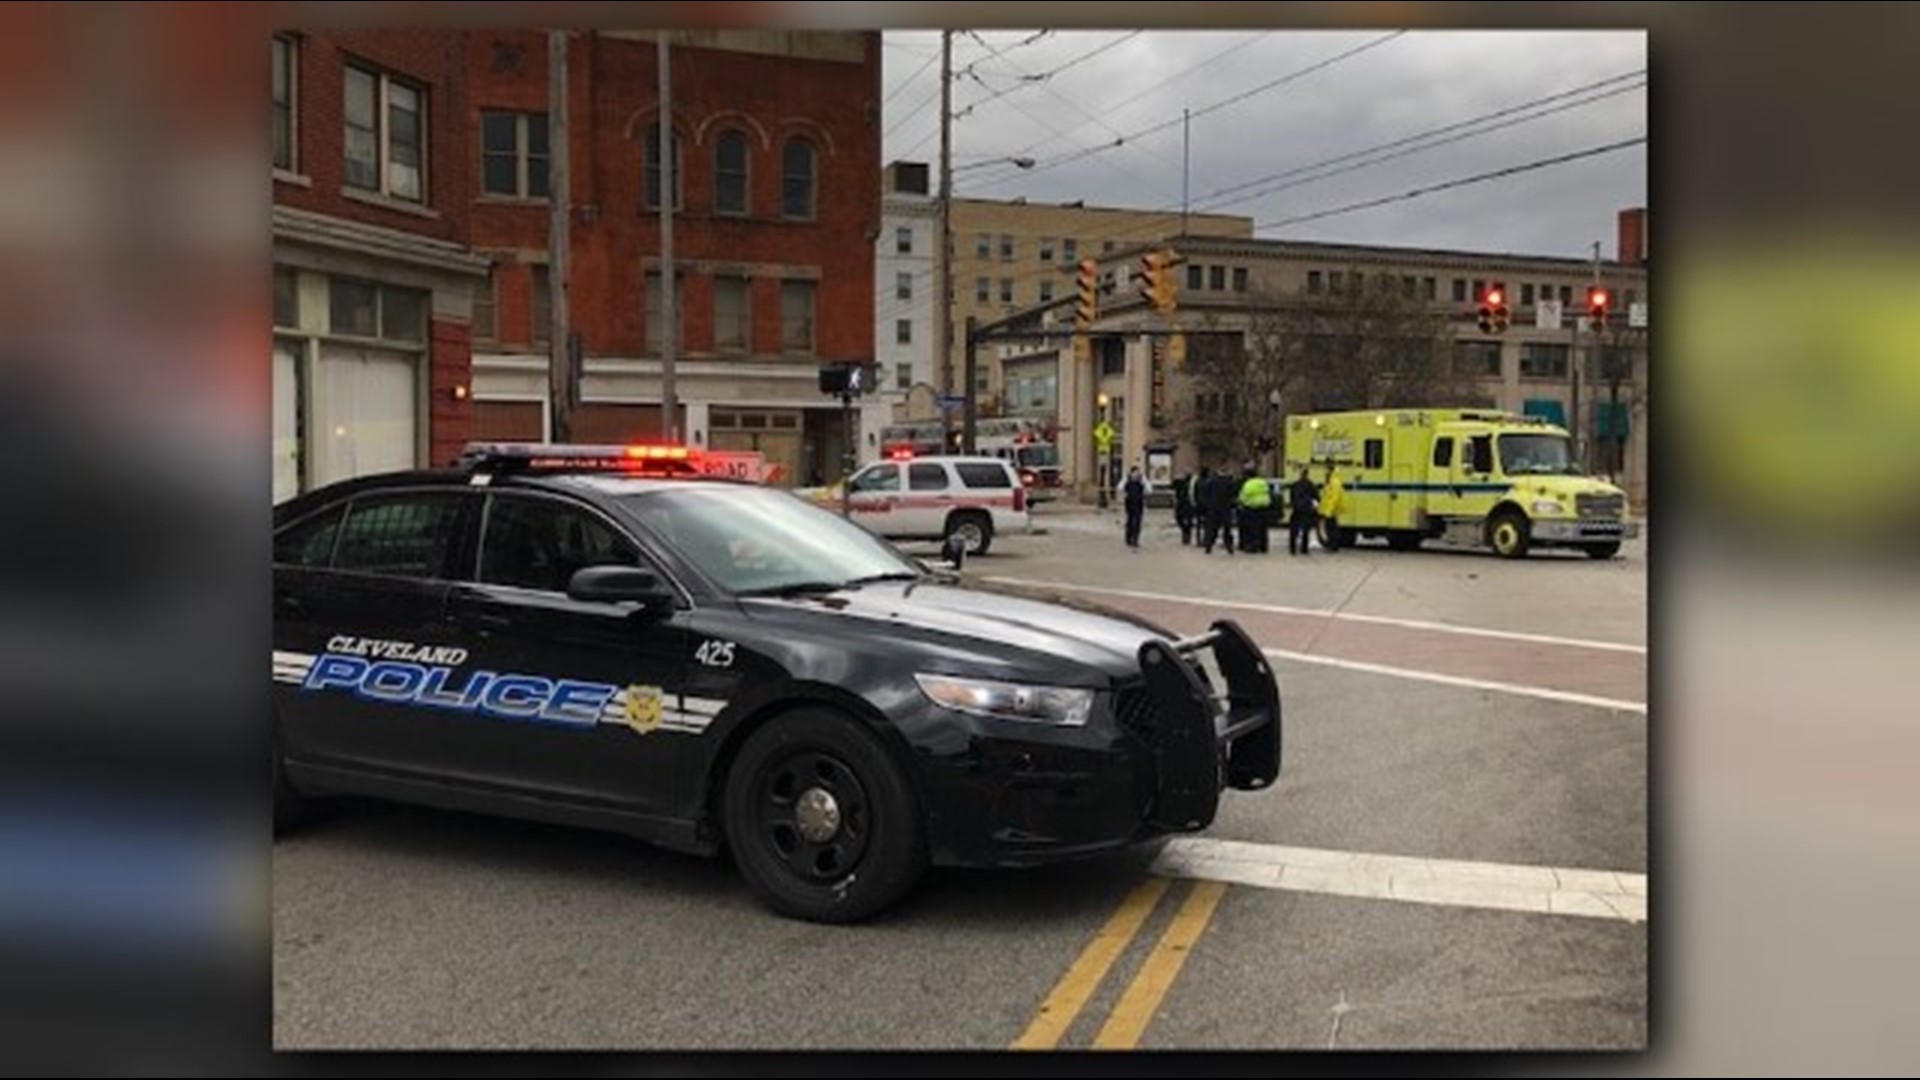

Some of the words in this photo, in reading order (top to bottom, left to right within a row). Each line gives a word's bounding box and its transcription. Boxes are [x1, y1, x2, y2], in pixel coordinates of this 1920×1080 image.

[326, 635, 468, 665] CLEVELAND
[694, 639, 736, 667] 425
[305, 653, 617, 724] POLICE
